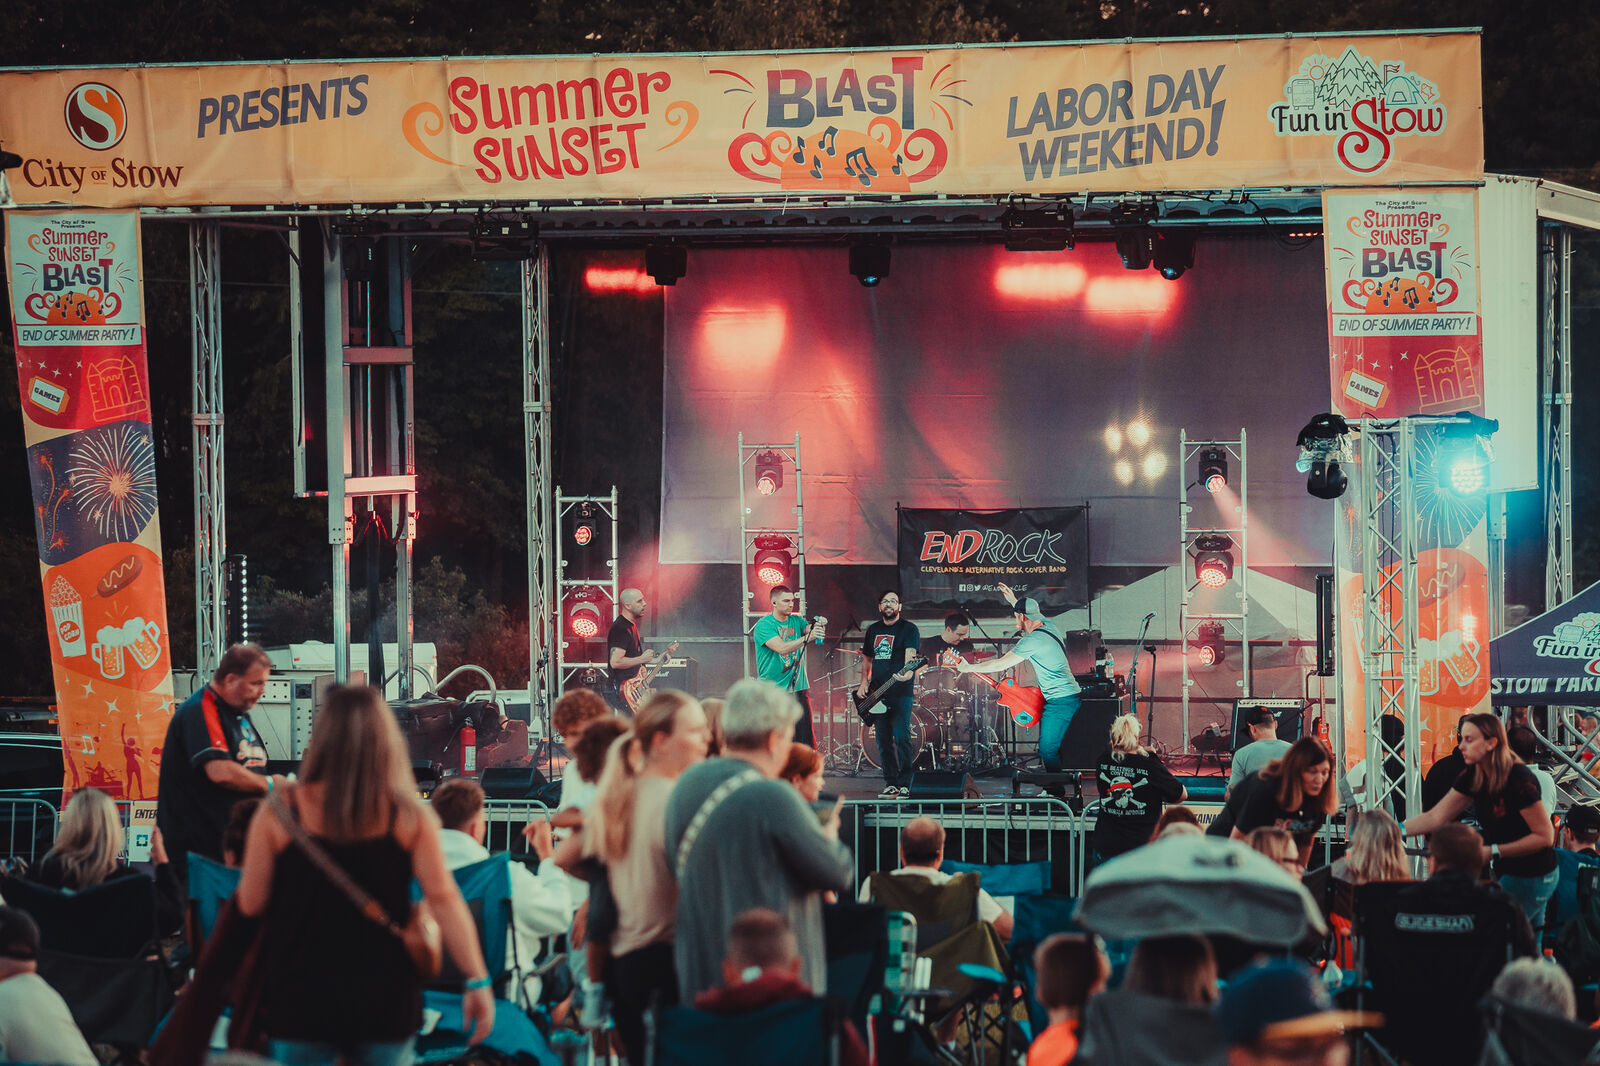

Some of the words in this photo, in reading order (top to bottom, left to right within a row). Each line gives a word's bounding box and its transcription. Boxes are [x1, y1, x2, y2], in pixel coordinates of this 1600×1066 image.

[448, 67, 671, 134] Summer
[766, 56, 924, 130] BLAST
[1006, 79, 1134, 138] LABOR
[1144, 64, 1226, 117] DAY
[197, 74, 369, 138] PRESENTS
[1018, 98, 1226, 182] WEEKEND!
[1271, 105, 1320, 133] Fun
[1325, 106, 1348, 131] in
[1337, 96, 1443, 173] Stow
[473, 122, 646, 184] SUNSET
[23, 158, 87, 193] City
[91, 169, 107, 181] OF
[112, 157, 184, 188] Stow
[1363, 209, 1442, 228] Summer
[42, 228, 109, 246] Summer
[1370, 228, 1429, 246] SUNSET
[48, 246, 100, 262] SUNSET
[1362, 241, 1447, 279] BLAST
[43, 258, 114, 294] BLAST
[1338, 319, 1360, 331] END
[1362, 319, 1379, 331] OF
[1379, 318, 1429, 331] SUMMER
[22, 329, 42, 341] END
[44, 329, 59, 341] OF
[59, 329, 100, 341] SUMMER
[33, 387, 61, 404] GAMES
[1349, 380, 1380, 399] GAMES
[920, 565, 964, 573] CLEVELAND'S
[964, 566, 1005, 574] ALTERNATIVE
[1006, 566, 1024, 574] ROCK
[1049, 565, 1067, 573] BAND
[60, 623, 71, 635] POP
[64, 629, 80, 640] CORN
[1537, 638, 1579, 657] Fun
[1490, 677, 1549, 694] STOW
